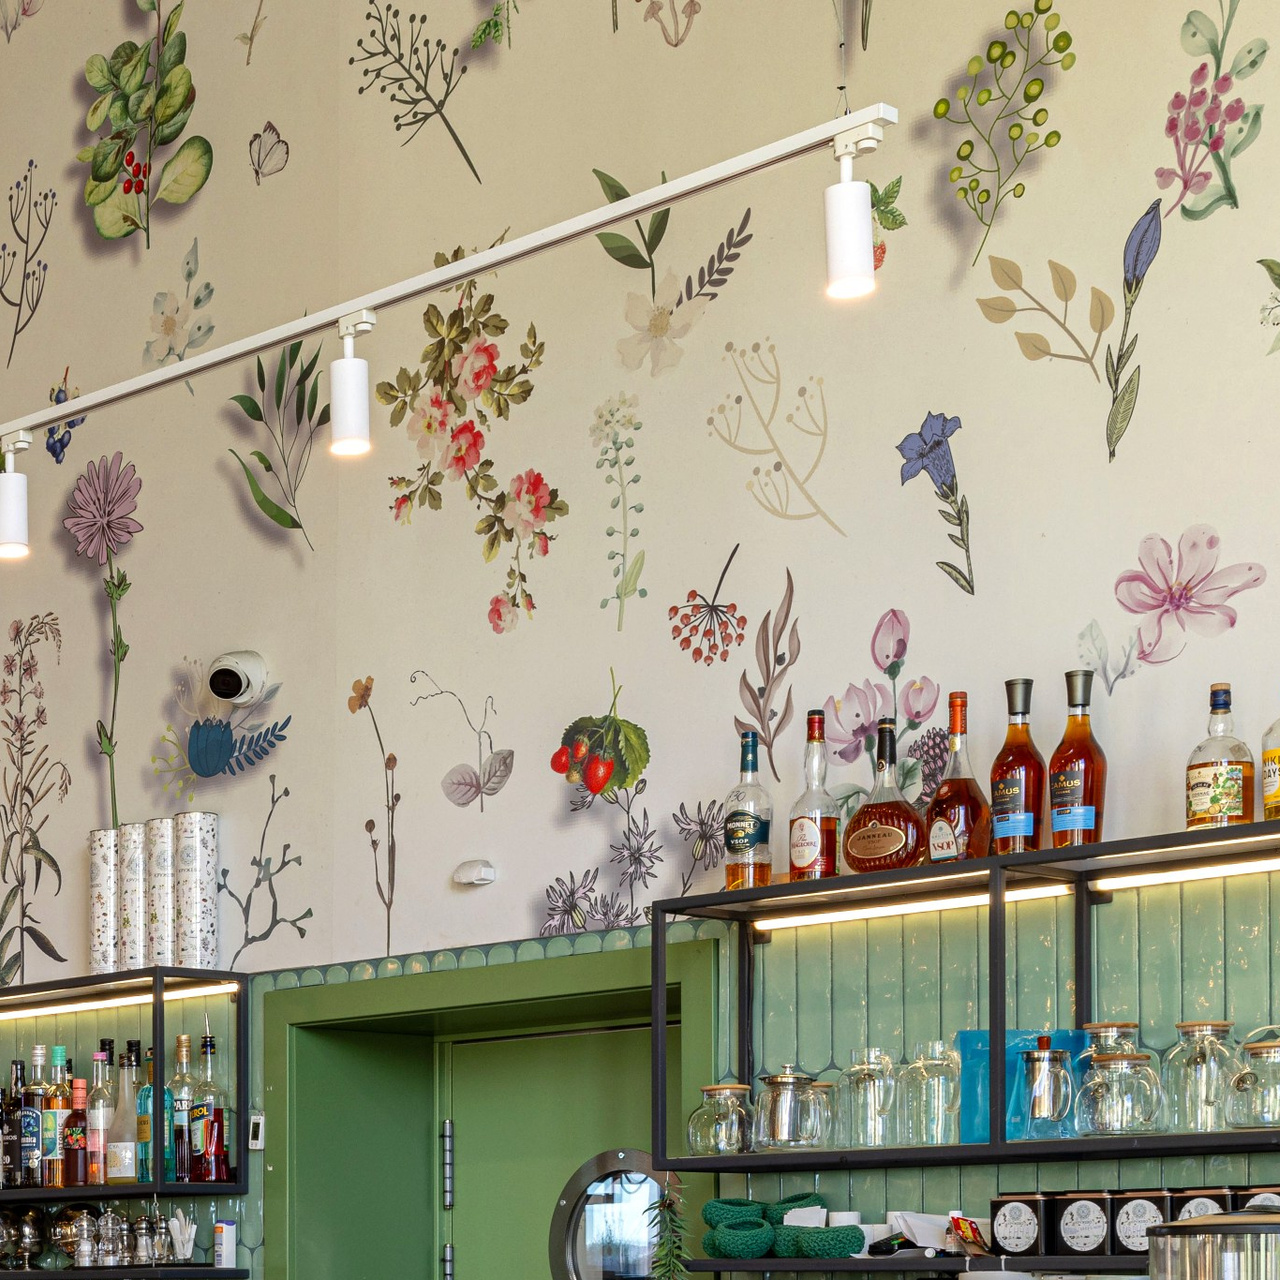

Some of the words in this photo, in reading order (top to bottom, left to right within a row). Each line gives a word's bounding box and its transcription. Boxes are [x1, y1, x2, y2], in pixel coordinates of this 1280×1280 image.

[993, 787, 1020, 797] AMUS
[727, 820, 755, 830] MONNET
[855, 832, 893, 841] JANNEAU
[931, 840, 955, 852] VSOP
